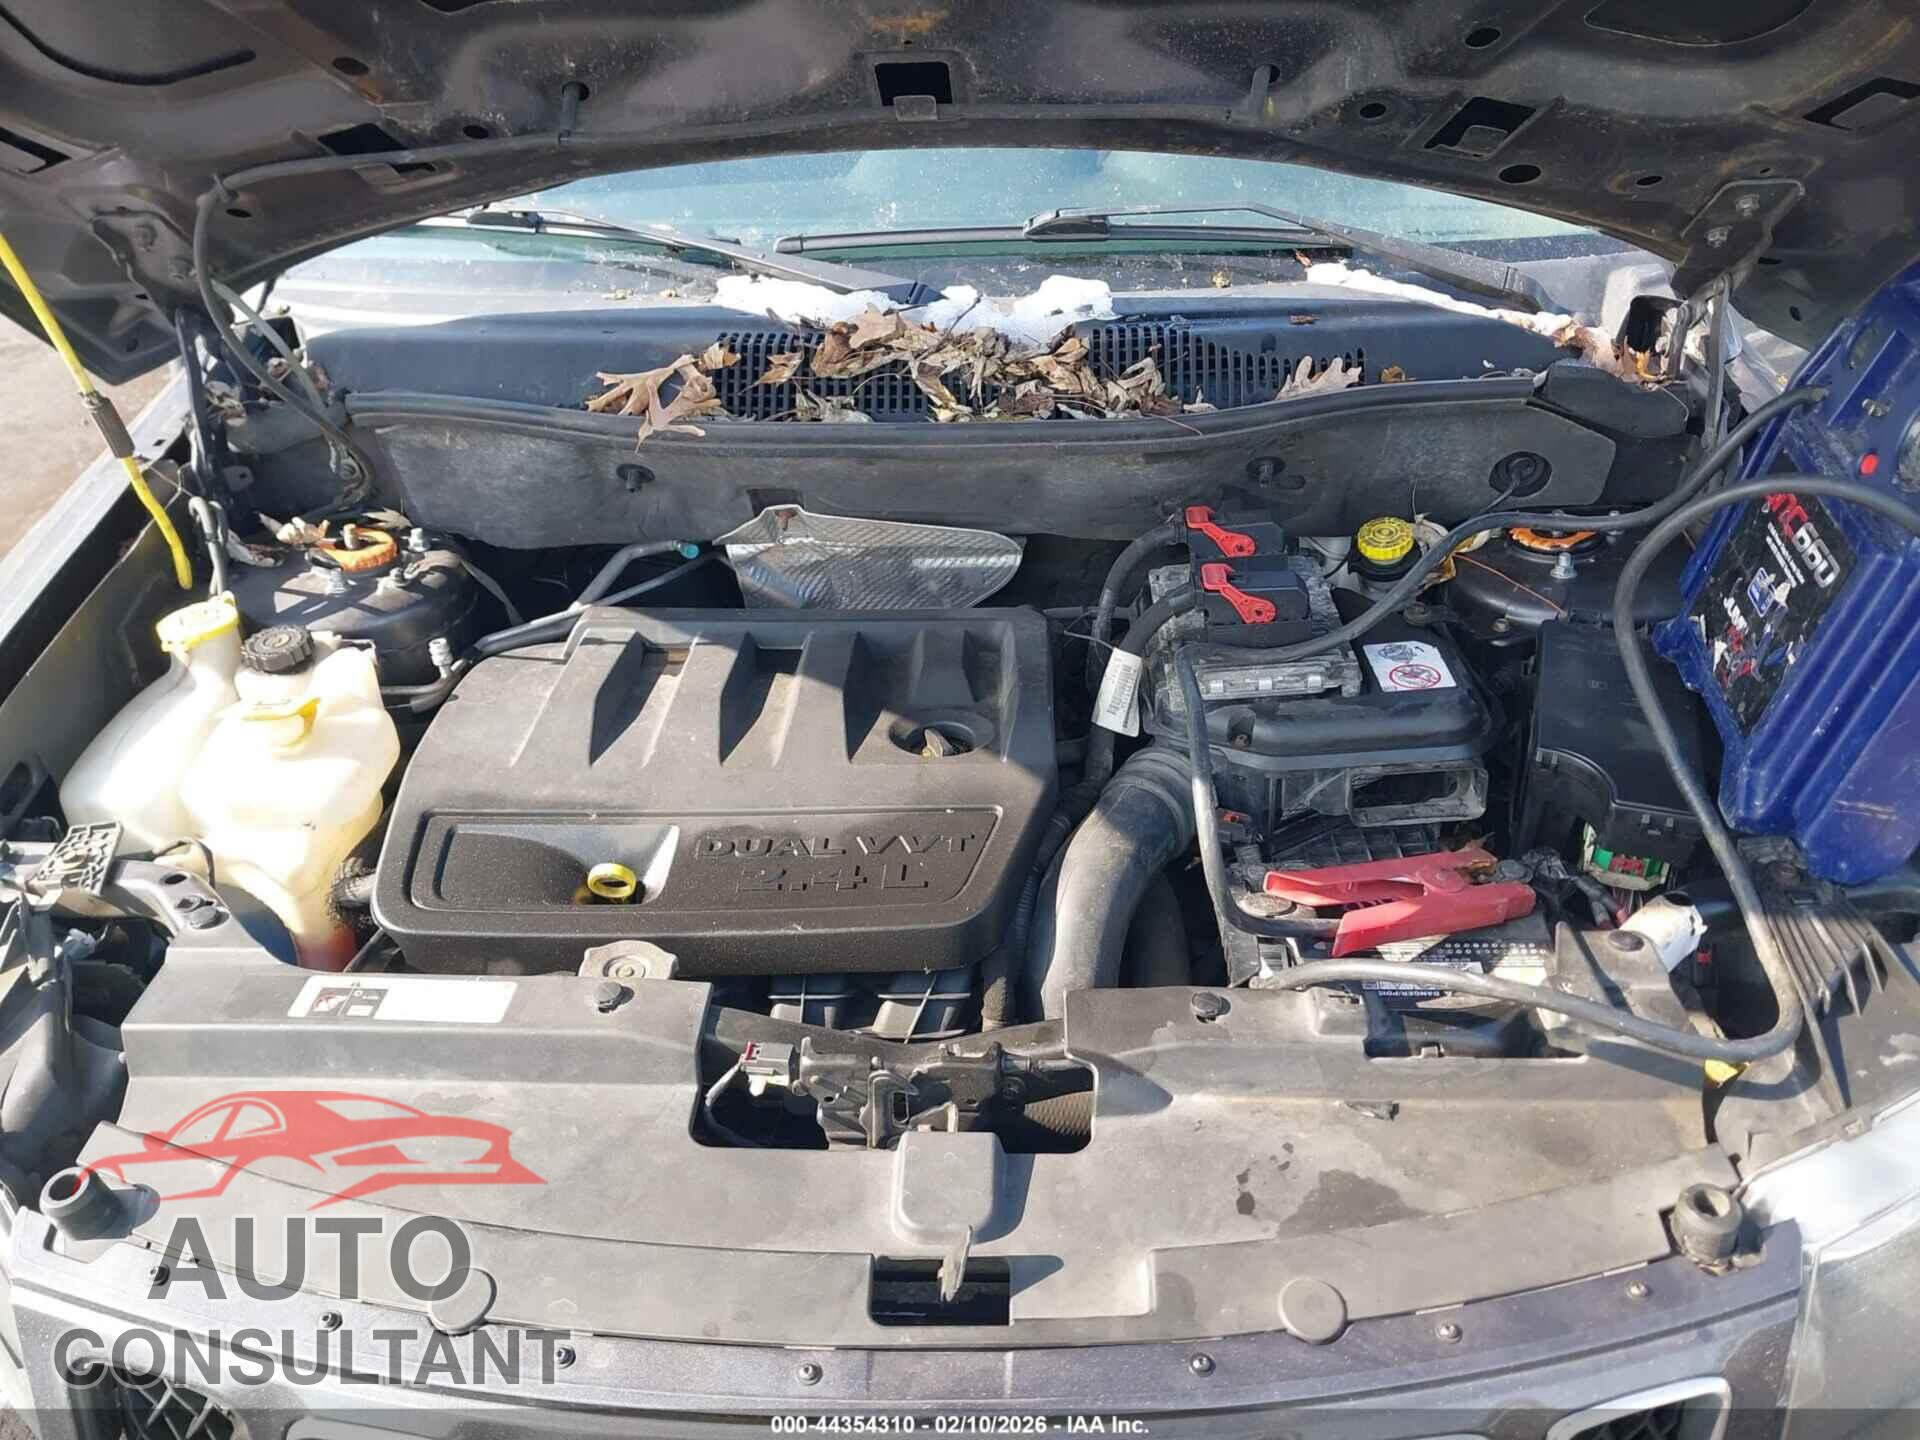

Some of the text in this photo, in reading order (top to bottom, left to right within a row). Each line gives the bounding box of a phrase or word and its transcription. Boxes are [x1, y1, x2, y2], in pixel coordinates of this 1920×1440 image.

[694, 833, 976, 858] DUAL VVT
[735, 863, 929, 893] 2.4L
